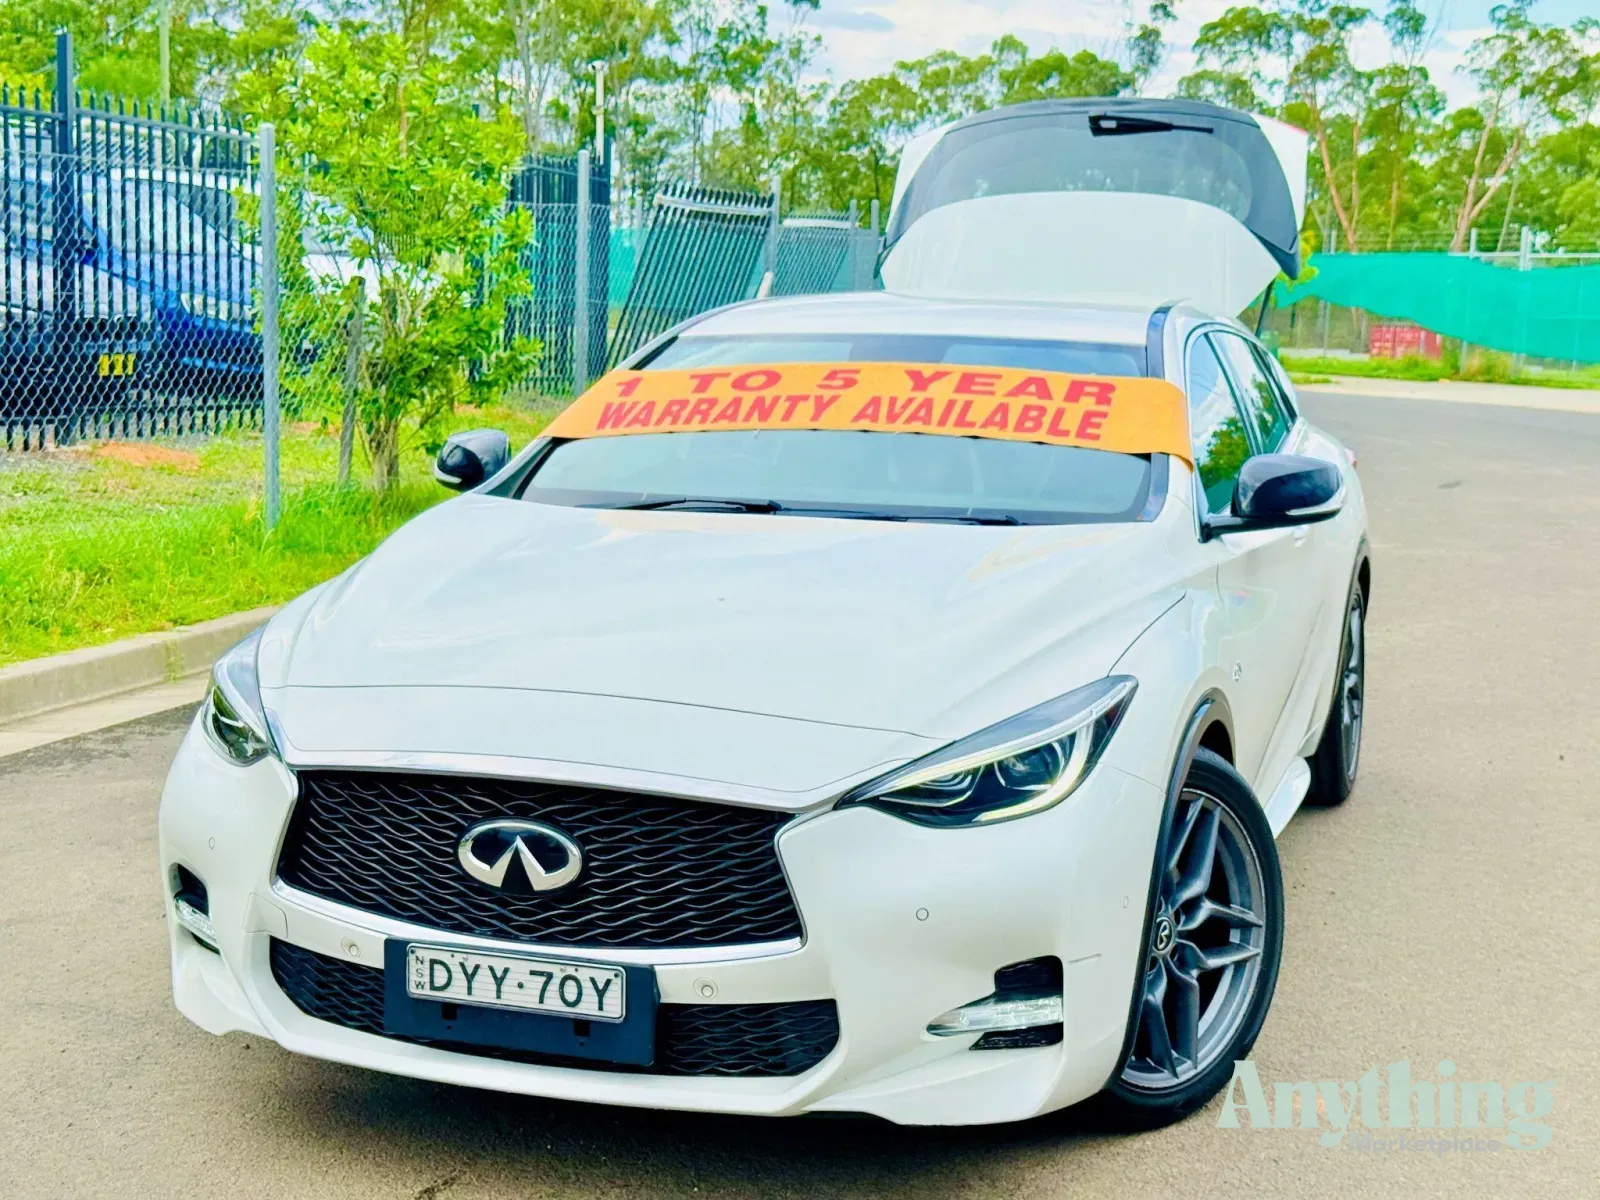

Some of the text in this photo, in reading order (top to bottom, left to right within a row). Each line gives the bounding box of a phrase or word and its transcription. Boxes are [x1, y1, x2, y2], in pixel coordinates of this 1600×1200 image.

[614, 369, 1117, 405] 1 TO 5 YEAR
[596, 394, 1109, 441] WARRANTY AVAILABLE
